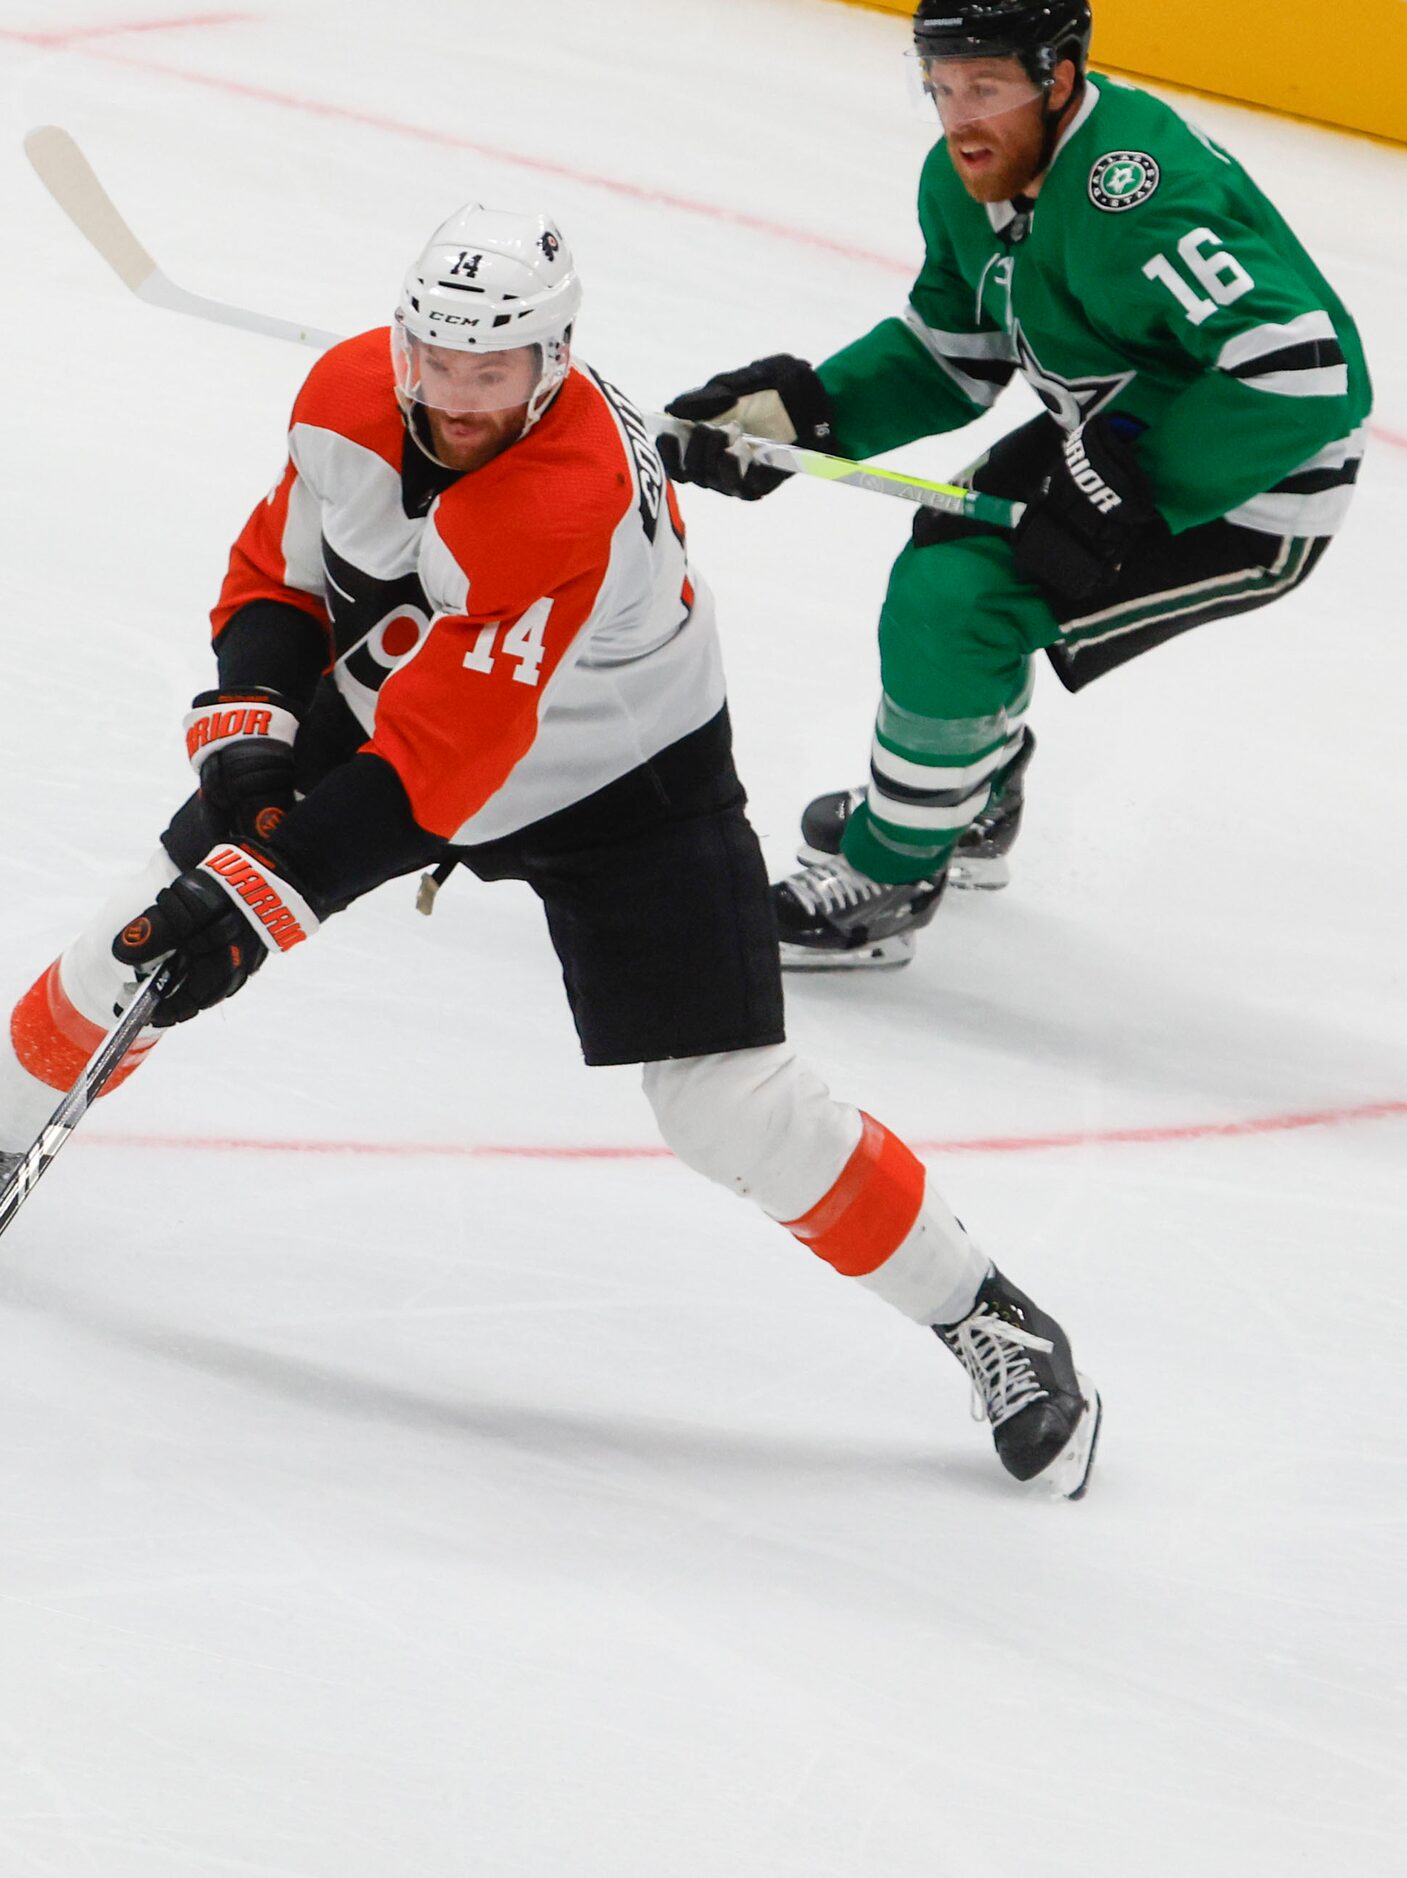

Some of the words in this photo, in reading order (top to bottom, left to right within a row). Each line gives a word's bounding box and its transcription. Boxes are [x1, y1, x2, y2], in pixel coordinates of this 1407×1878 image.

[450, 251, 483, 279] 14
[1142, 227, 1255, 326] 16
[429, 309, 481, 327] CCM
[814, 421, 831, 437] 16
[462, 596, 555, 687] 14
